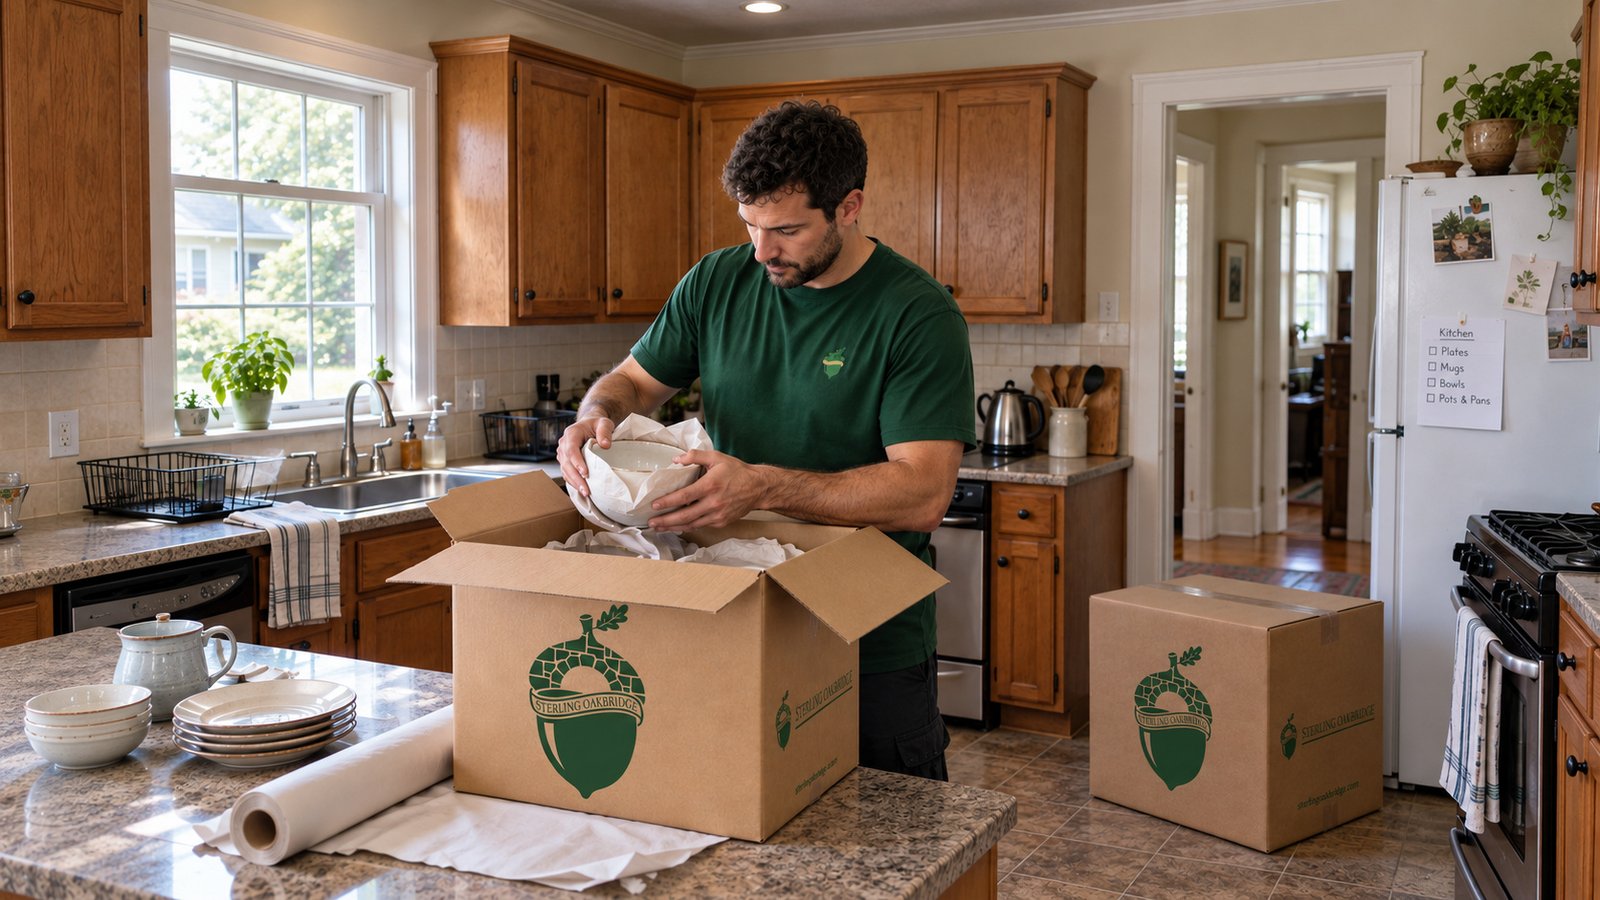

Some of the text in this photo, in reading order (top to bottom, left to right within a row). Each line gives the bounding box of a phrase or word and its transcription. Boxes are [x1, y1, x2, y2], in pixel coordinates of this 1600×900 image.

[1439, 328, 1474, 338] Kitchen
[1441, 346, 1469, 357] Plates
[1440, 362, 1465, 376] Mugs
[1439, 378, 1466, 389] Bowls
[1439, 393, 1491, 405] Pots & Pans
[535, 696, 638, 714] STERLING OAKBRIDGE
[1301, 717, 1337, 739] STERLING
